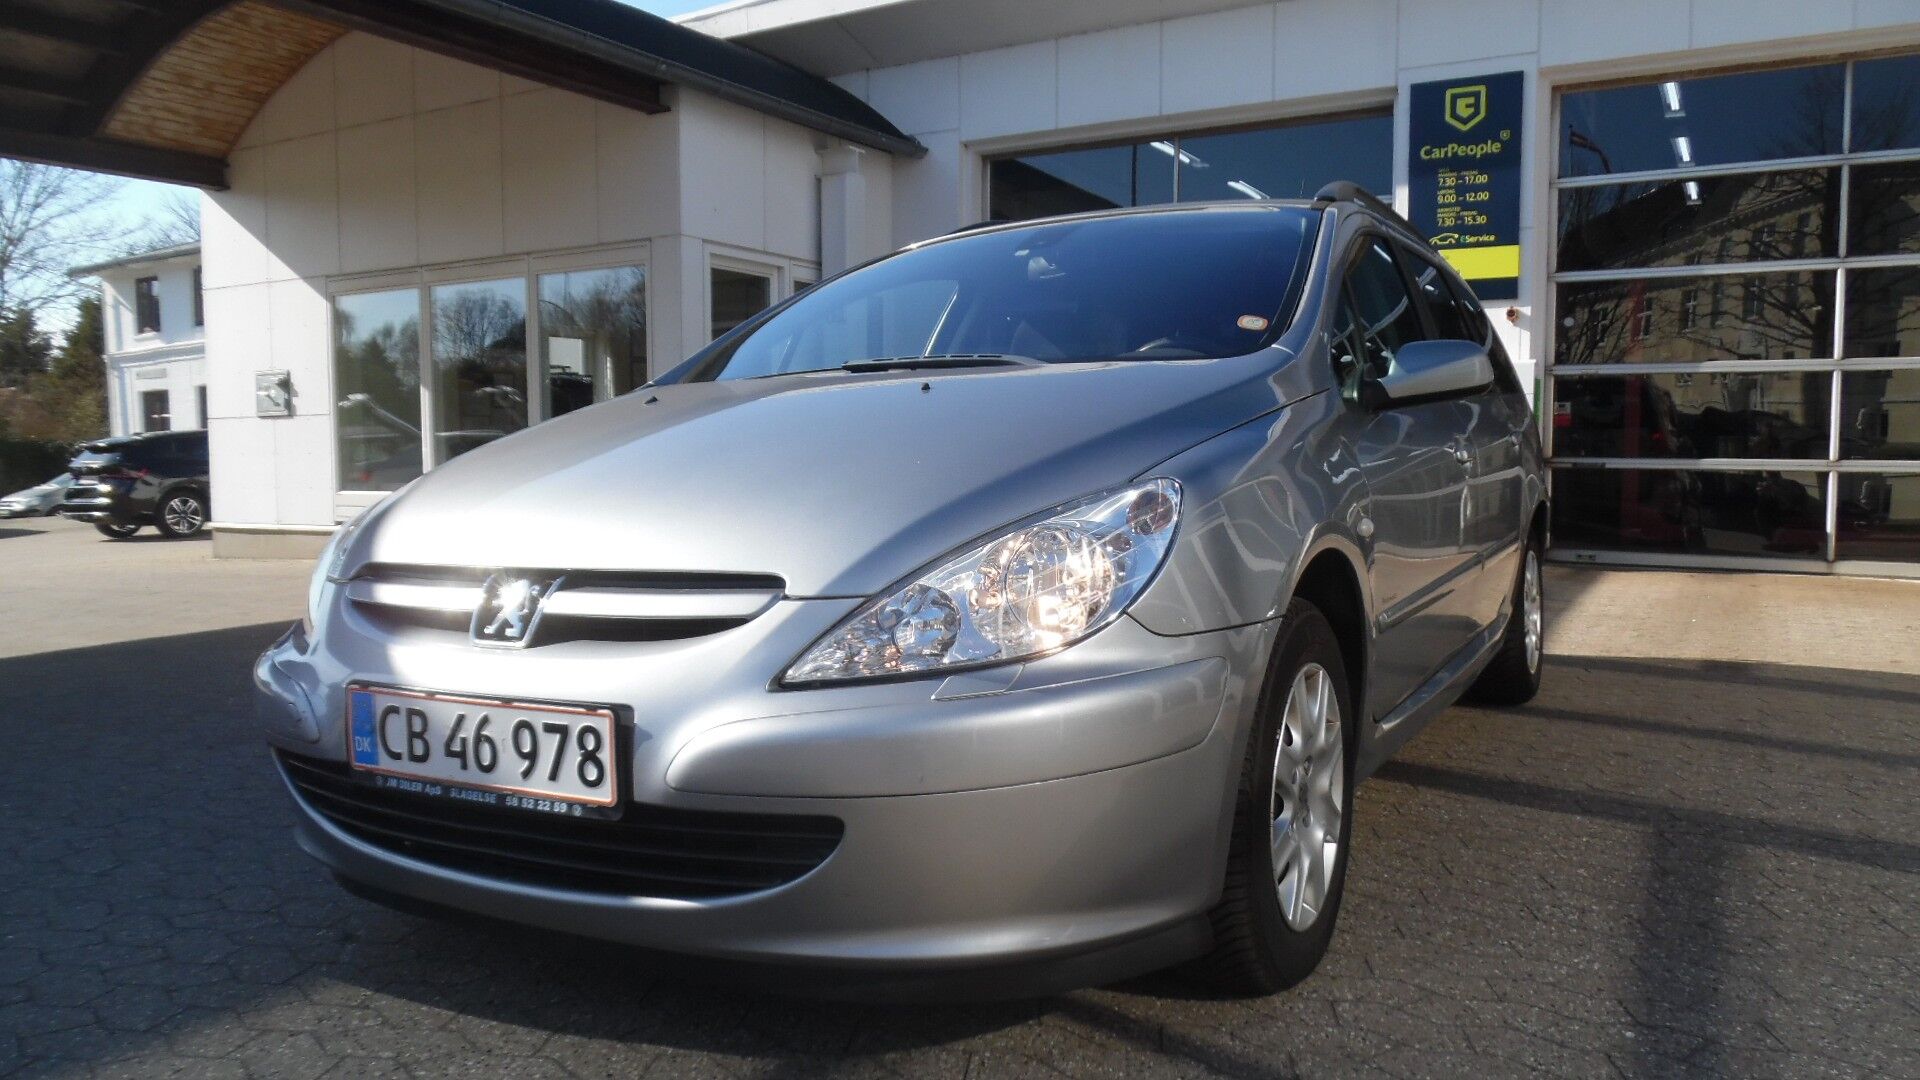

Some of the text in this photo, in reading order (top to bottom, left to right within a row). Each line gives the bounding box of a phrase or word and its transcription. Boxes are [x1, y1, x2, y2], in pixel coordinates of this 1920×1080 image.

[1420, 140, 1502, 159] CarPeople
[1464, 174, 1489, 185] 17.00
[1465, 191, 1490, 201] 12.00
[1464, 215, 1488, 225] 15.30
[355, 735, 371, 753] DK
[379, 704, 605, 788] CB 46 978
[536, 800, 551, 812] 22
